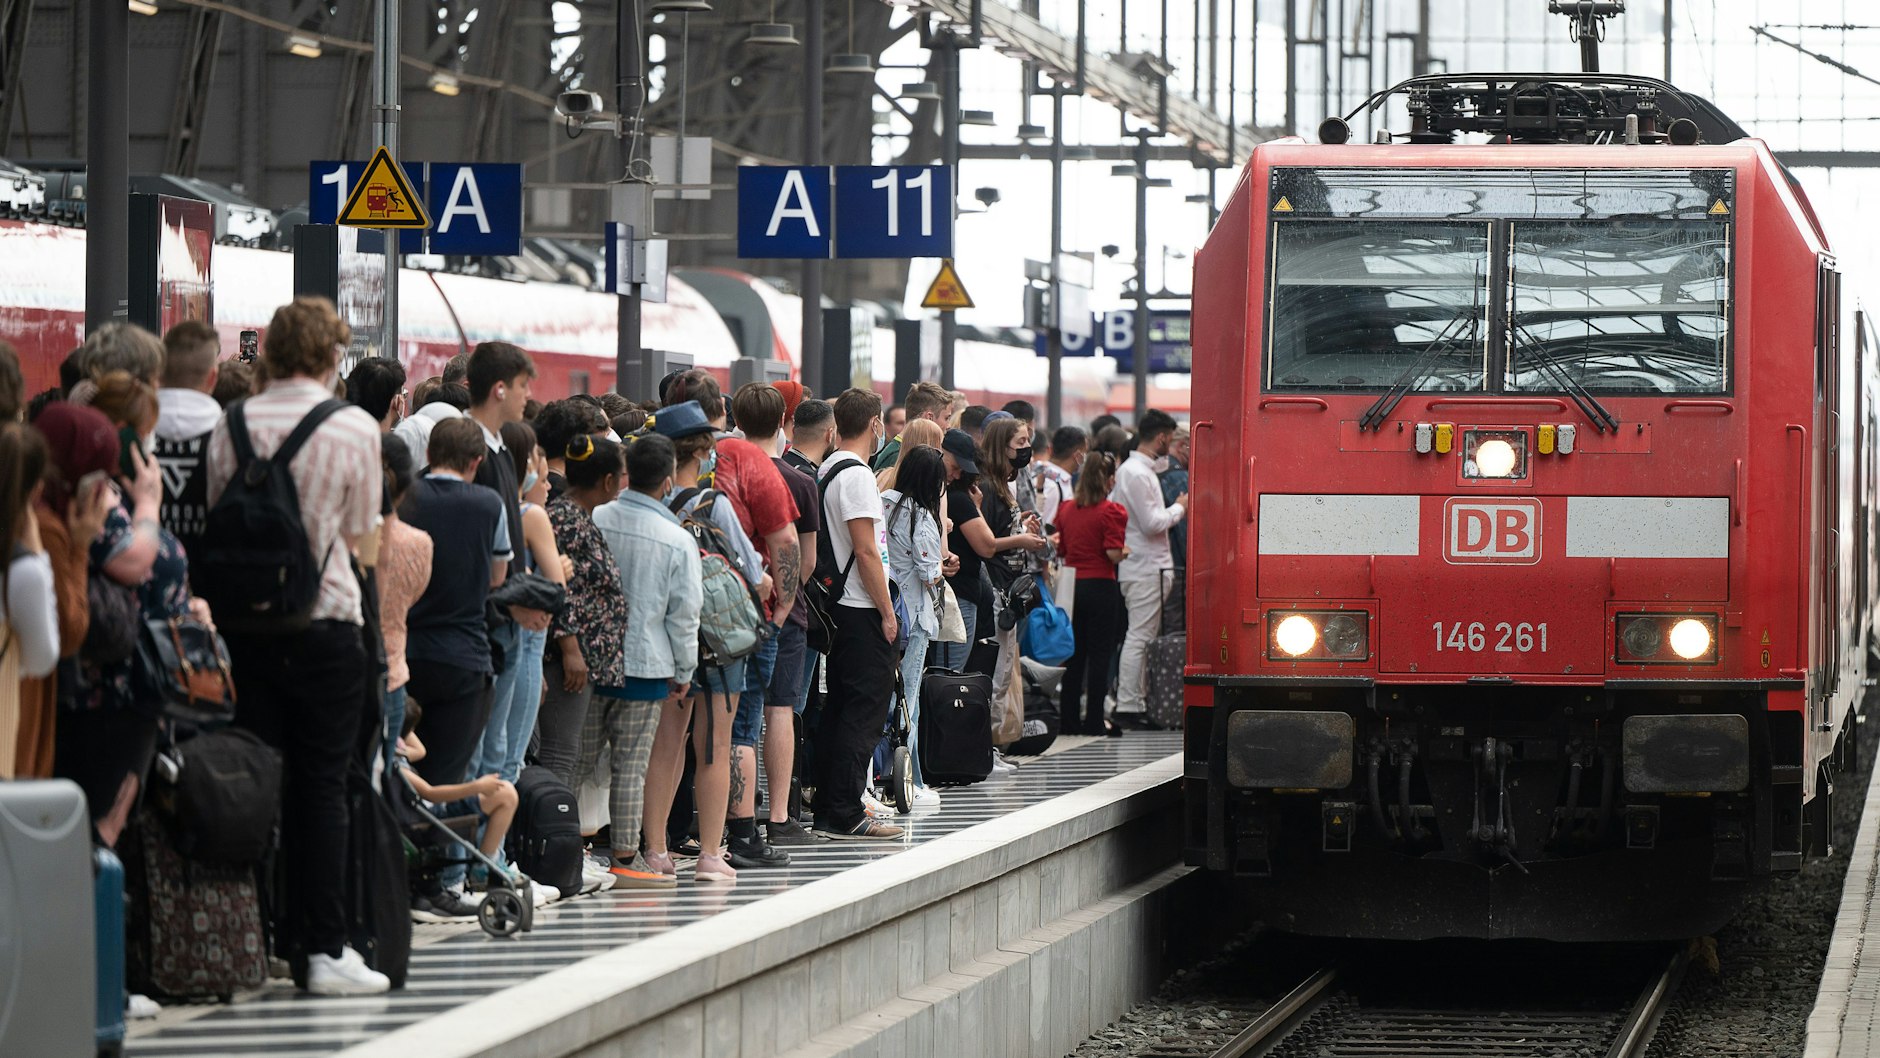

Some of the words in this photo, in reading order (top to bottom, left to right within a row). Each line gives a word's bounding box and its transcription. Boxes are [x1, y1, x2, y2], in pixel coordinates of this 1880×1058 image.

[437, 166, 491, 233] A
[765, 169, 821, 236] A
[871, 168, 932, 236] 11
[1104, 312, 1134, 350] B
[1456, 508, 1530, 553] DB
[1432, 621, 1486, 652] 146
[1494, 621, 1548, 652] 261
